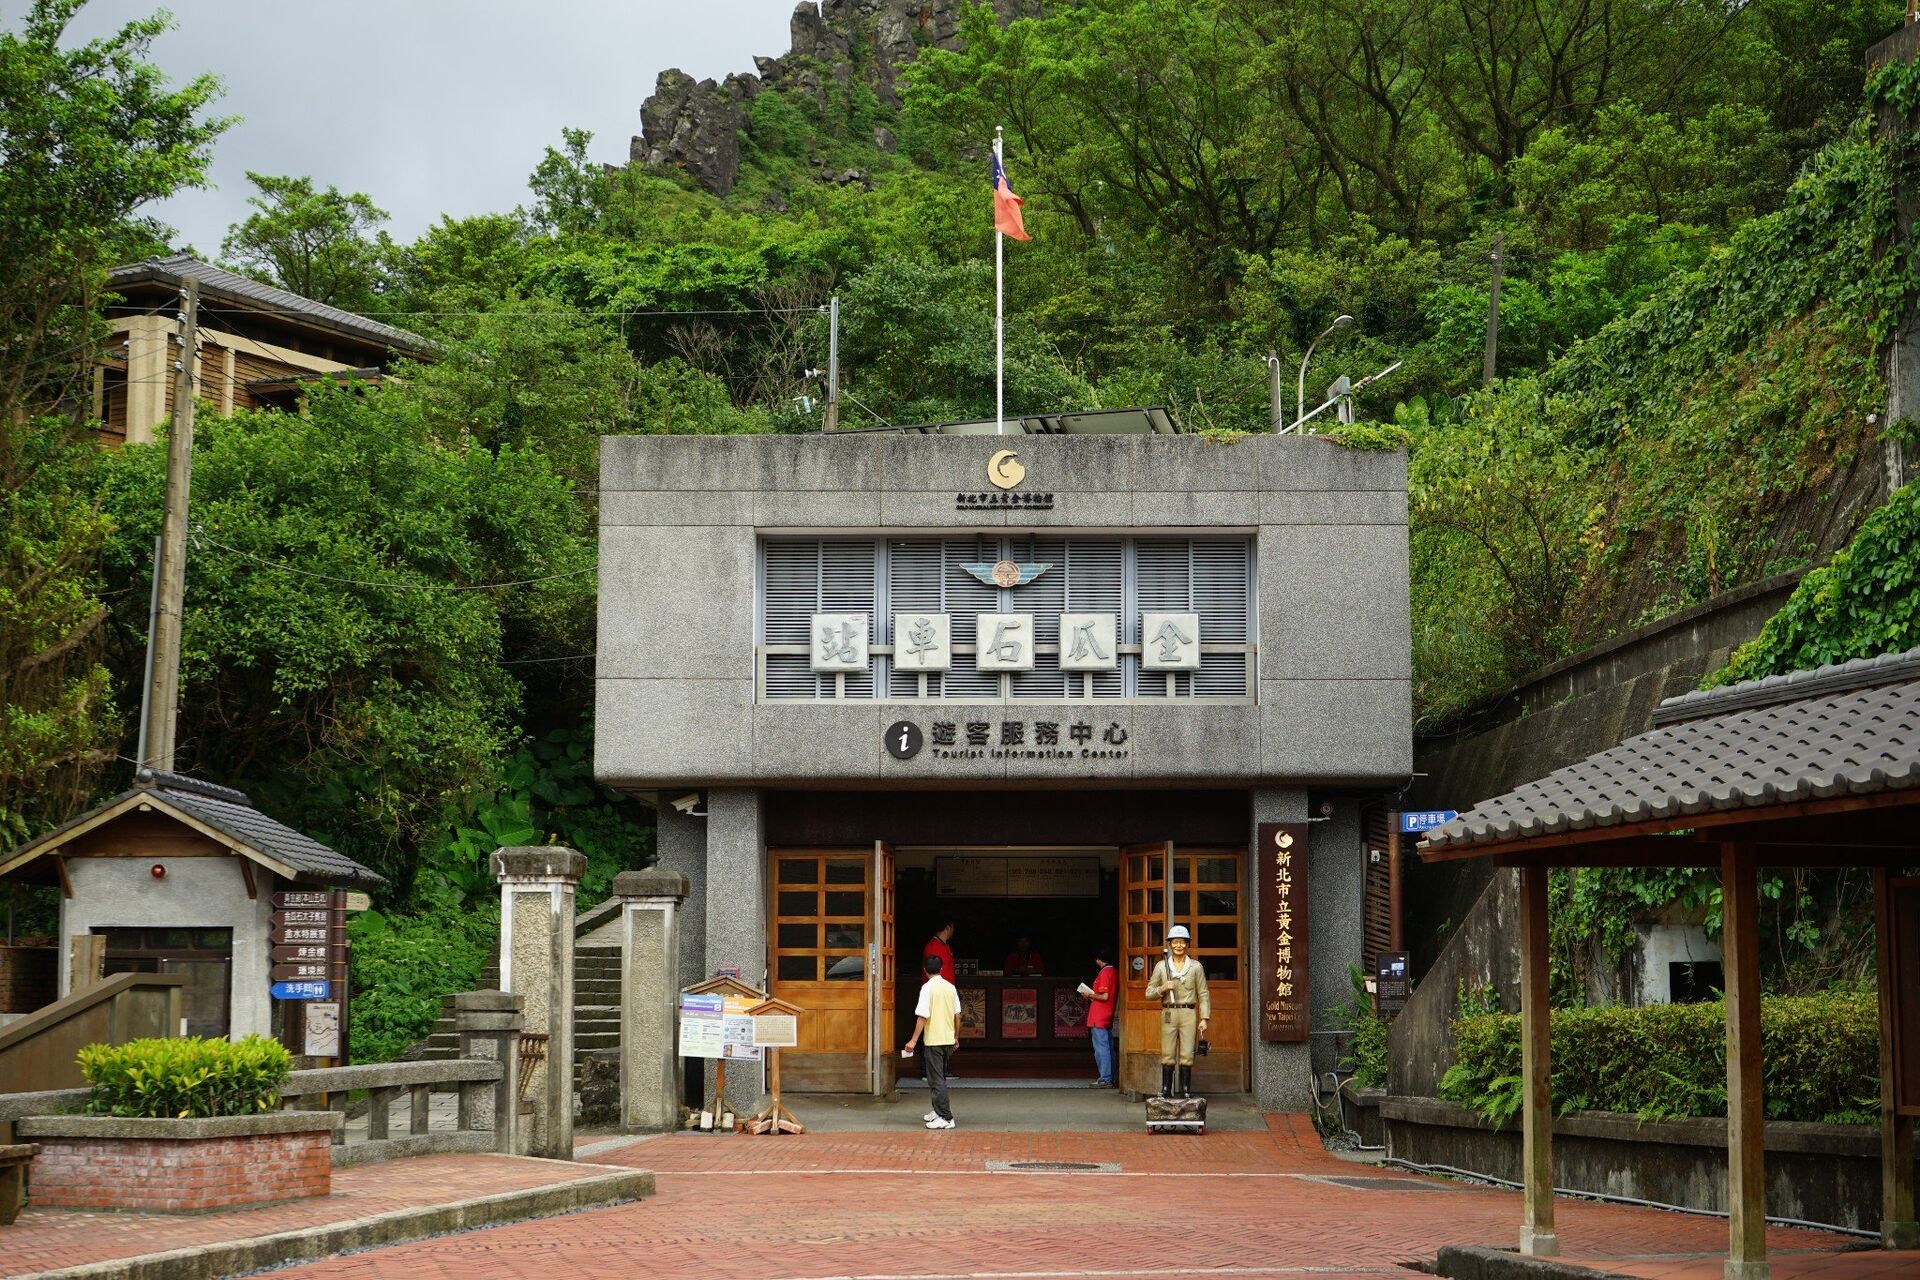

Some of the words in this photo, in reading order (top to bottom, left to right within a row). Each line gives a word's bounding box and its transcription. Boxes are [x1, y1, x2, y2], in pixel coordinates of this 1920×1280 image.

[932, 721, 1128, 745] 遊客服務中心
[933, 749, 984, 759] Tourist
[990, 749, 1073, 759] Information
[1081, 749, 1129, 759] Center
[1420, 813, 1446, 825] 停車場
[1276, 851, 1293, 997] 新北市立黃金博物館
[286, 983, 312, 993] 洗手間
[1266, 1000, 1279, 1010] Gold
